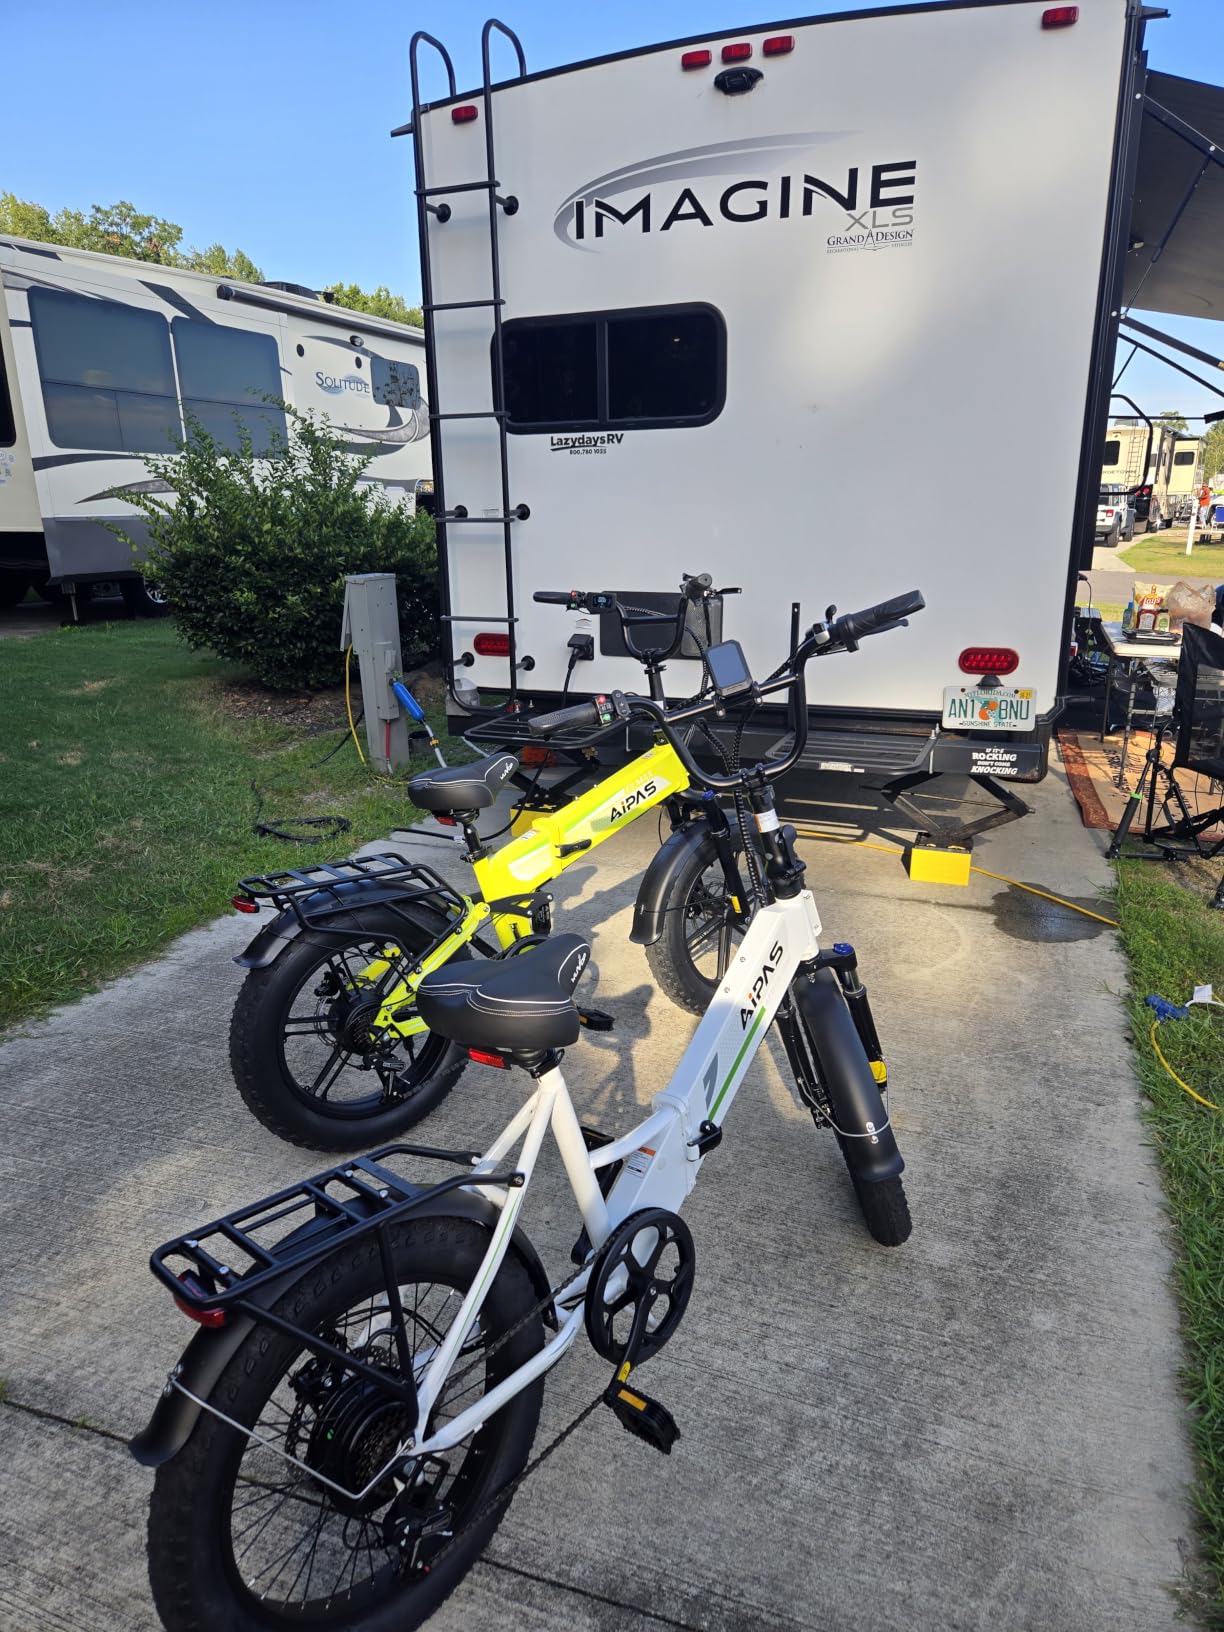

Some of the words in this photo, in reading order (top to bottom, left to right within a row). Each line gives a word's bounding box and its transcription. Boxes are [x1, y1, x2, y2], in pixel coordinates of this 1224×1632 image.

[575, 160, 917, 240] IMAGINE
[845, 206, 914, 231] XLS
[827, 234, 865, 246] GRAND
[875, 229, 913, 242] DESIGN
[315, 371, 370, 394] SOLITUDE
[948, 698, 976, 719] AN1
[972, 752, 1017, 761] ROCKING
[971, 765, 1018, 775] KNOCKING
